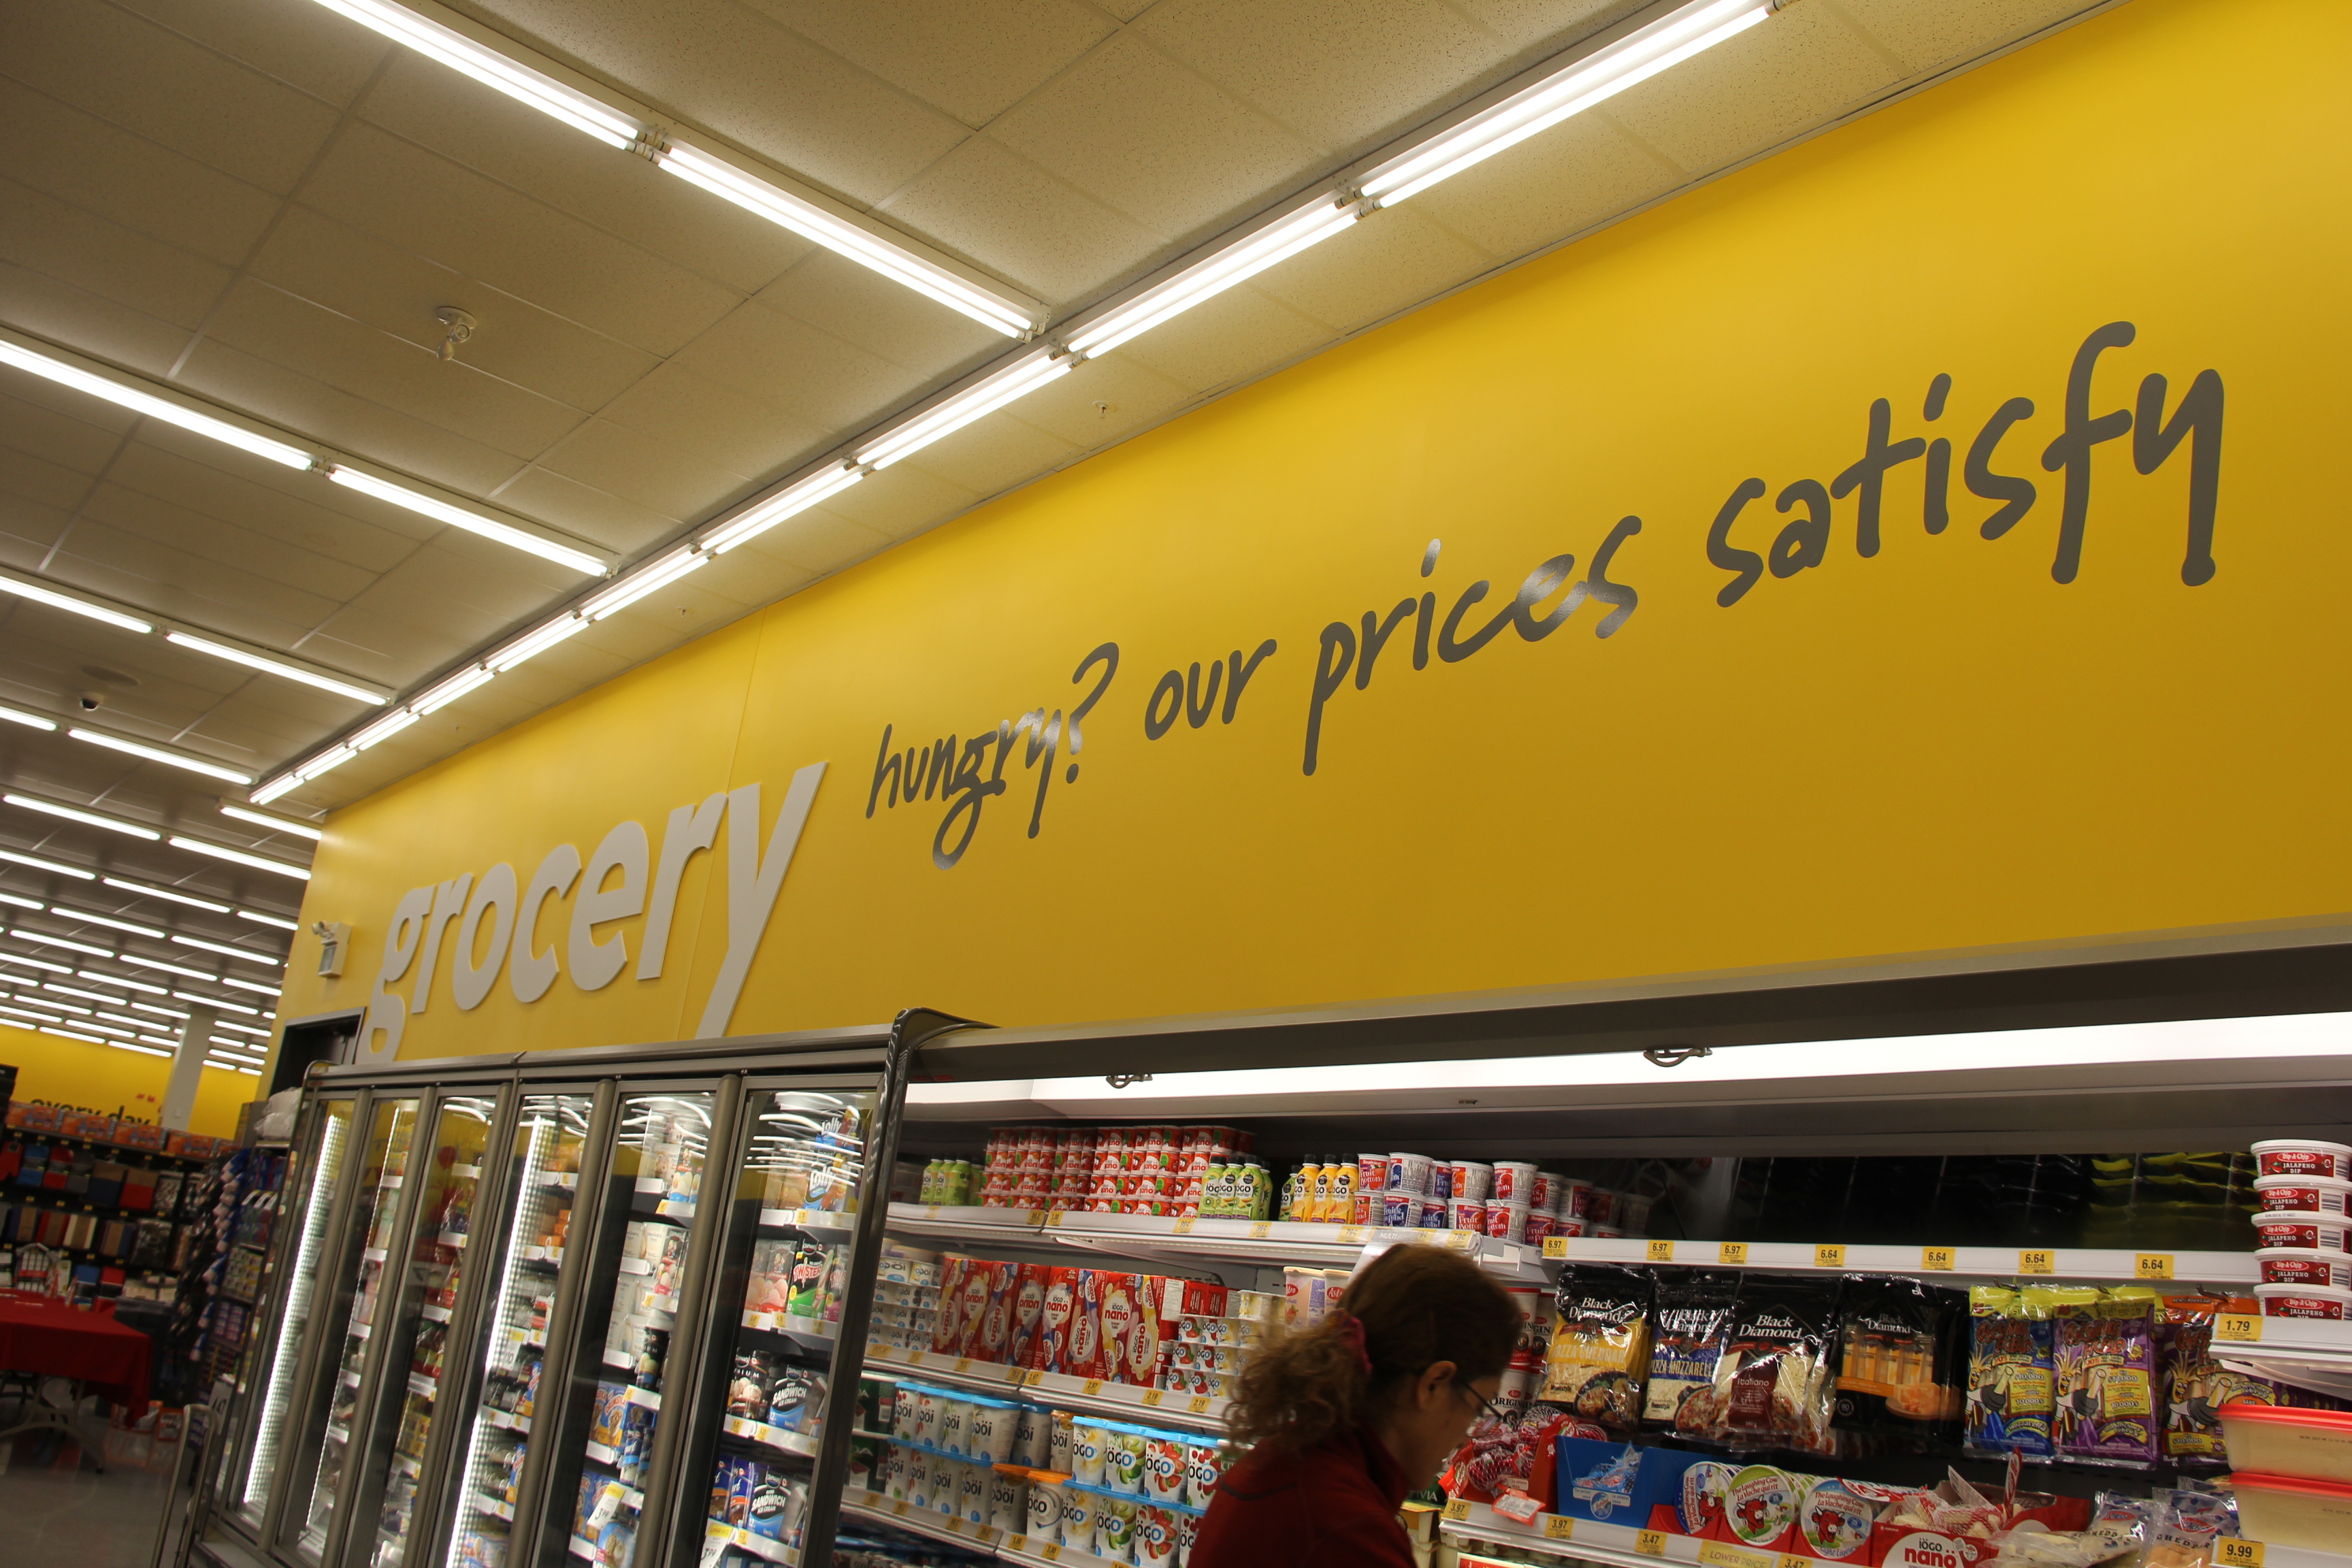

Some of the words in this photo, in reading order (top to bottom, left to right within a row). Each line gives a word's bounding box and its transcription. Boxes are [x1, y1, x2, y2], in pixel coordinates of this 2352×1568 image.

[865, 642, 1120, 870] hungry?
[1145, 639, 1277, 740] our
[1303, 515, 1642, 777] prices
[1706, 321, 2224, 608] satisfy
[355, 761, 828, 1064] grocery
[1548, 1241, 1562, 1249] 6.97
[1652, 1243, 1667, 1252] 6.97
[1725, 1245, 1741, 1254] 6.97
[1820, 1249, 1838, 1258] 6.64
[1928, 1252, 1946, 1262] 6.64
[2025, 1254, 2045, 1263] 6.64
[2142, 1259, 2163, 1269] 6.64
[1582, 1297, 1615, 1309] Black
[1755, 1314, 1794, 1327] Black
[1879, 1313, 1904, 1324] Black
[1868, 1320, 1910, 1334] Diamond
[2226, 1320, 2250, 1331] 1.79
[1738, 1324, 1803, 1339] Diamond
[1737, 1377, 1769, 1387] Italiano
[772, 1386, 806, 1405] SANDWICH
[1732, 1488, 1741, 1497] The
[1741, 1479, 1766, 1493] Laughing
[1744, 1488, 1761, 1498] Vache
[751, 1495, 786, 1511] SANDWICH
[1826, 1492, 1851, 1505] Laughing
[1852, 1499, 1864, 1509] Cow
[1450, 1503, 1465, 1512] 3.97
[1825, 1501, 1843, 1509] Vache
[1844, 1504, 1854, 1513] qui
[1552, 1520, 1567, 1529] 3.97
[1643, 1534, 1659, 1544] 3.47
[2227, 1544, 2252, 1558] 9.99
[1710, 1550, 1740, 1564] LOWER
[1741, 1556, 1766, 1568] PRICE
[1784, 1558, 1805, 1568] 3.47
[1905, 1548, 1957, 1568] nanö
